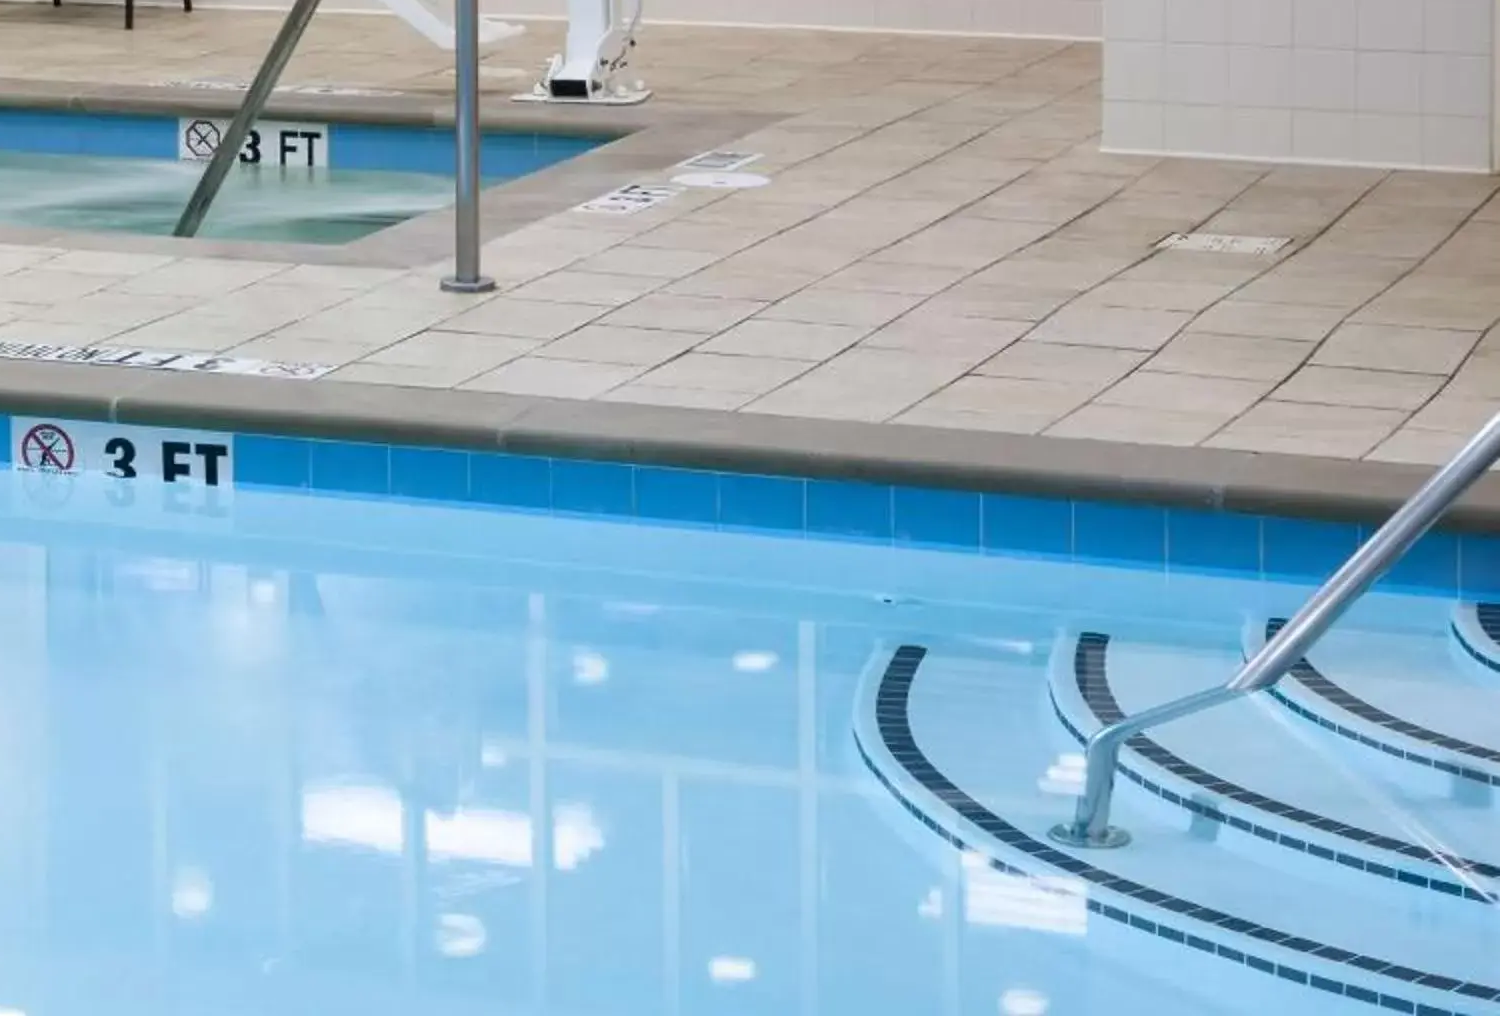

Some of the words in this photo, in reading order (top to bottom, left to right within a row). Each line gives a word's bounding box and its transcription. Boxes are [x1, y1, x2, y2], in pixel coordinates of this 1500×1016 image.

[238, 130, 262, 164] 3
[279, 130, 322, 167] FT
[104, 437, 137, 479] 3
[162, 440, 228, 487] FT
